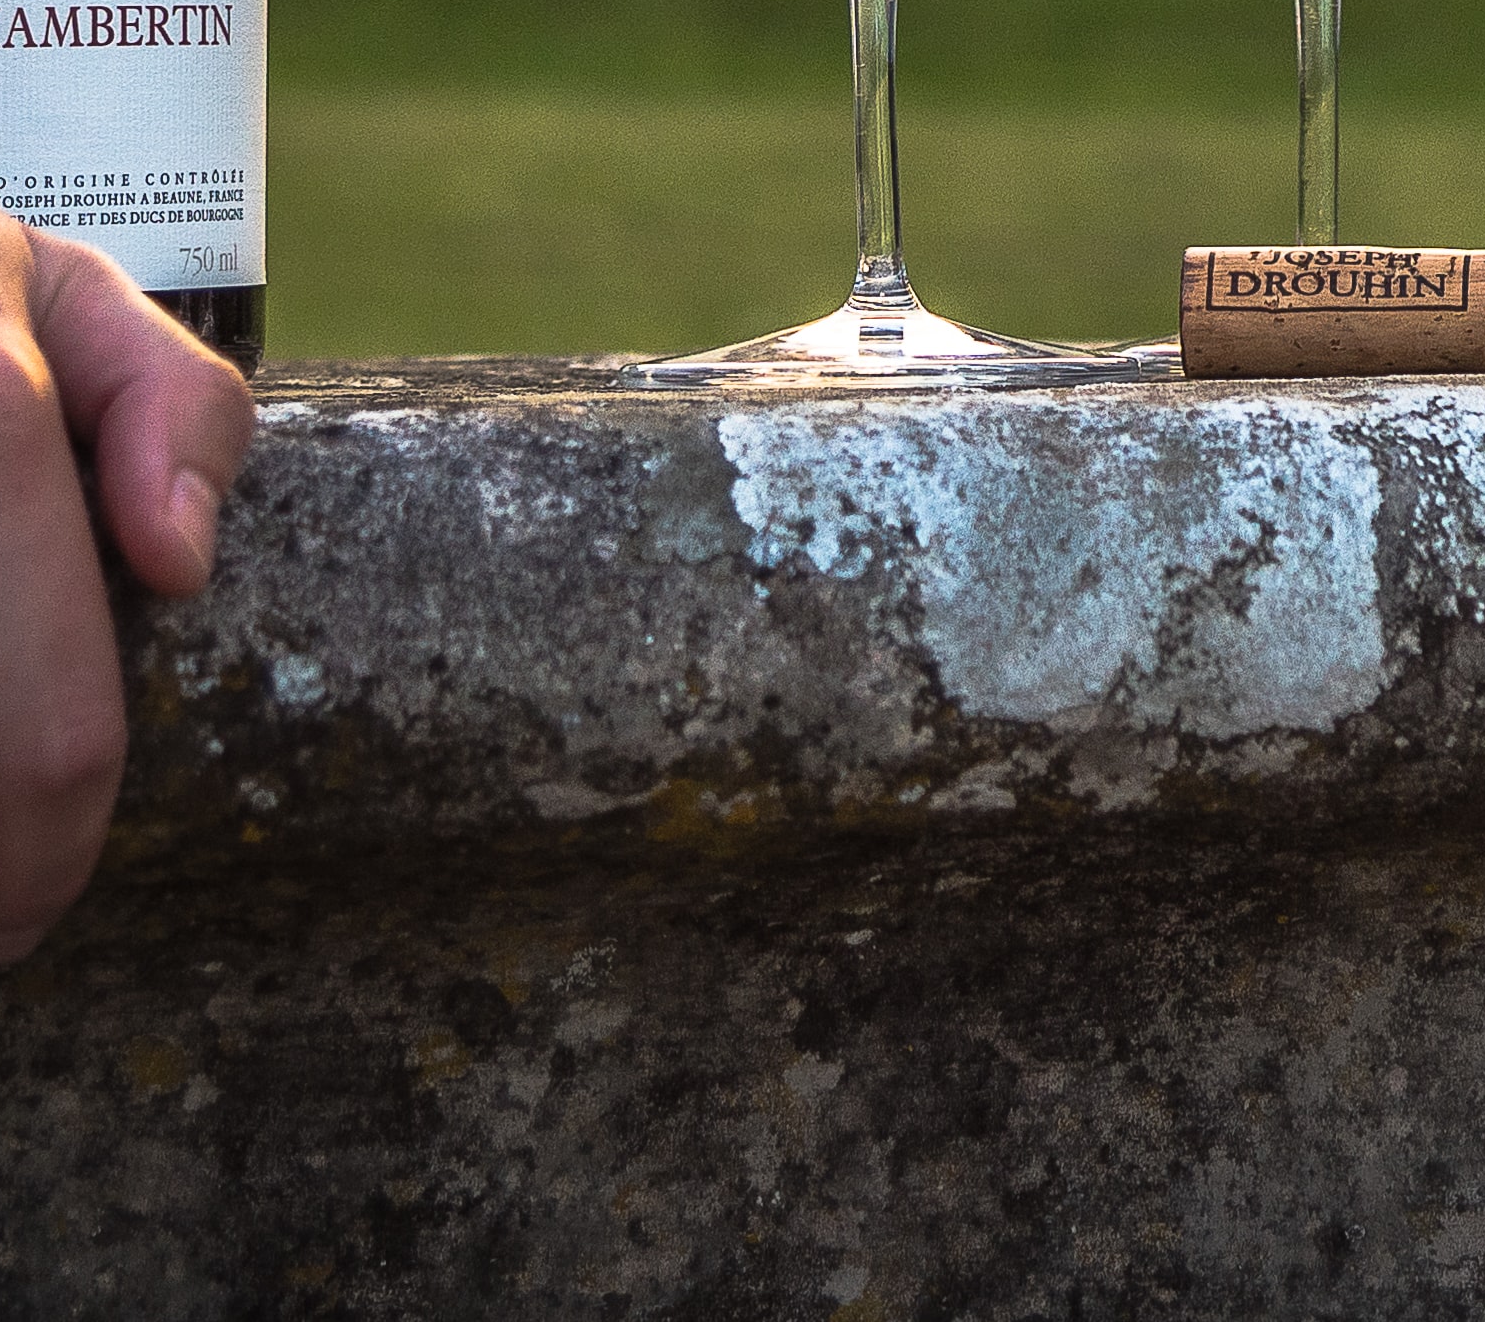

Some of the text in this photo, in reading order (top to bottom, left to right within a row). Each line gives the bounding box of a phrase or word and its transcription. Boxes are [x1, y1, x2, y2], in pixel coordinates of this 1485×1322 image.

[145, 168, 244, 186] CONTRÔLÉE
[61, 192, 136, 207] DROUHIN
[140, 193, 150, 205] A
[153, 190, 206, 205] BEAUNE,
[208, 189, 244, 203] FRANCE
[10, 207, 244, 227] RANCE ET DES DUCS DE BOURGOGNE
[179, 243, 238, 277] 750 ml
[1226, 269, 1448, 300] DROUHIN
